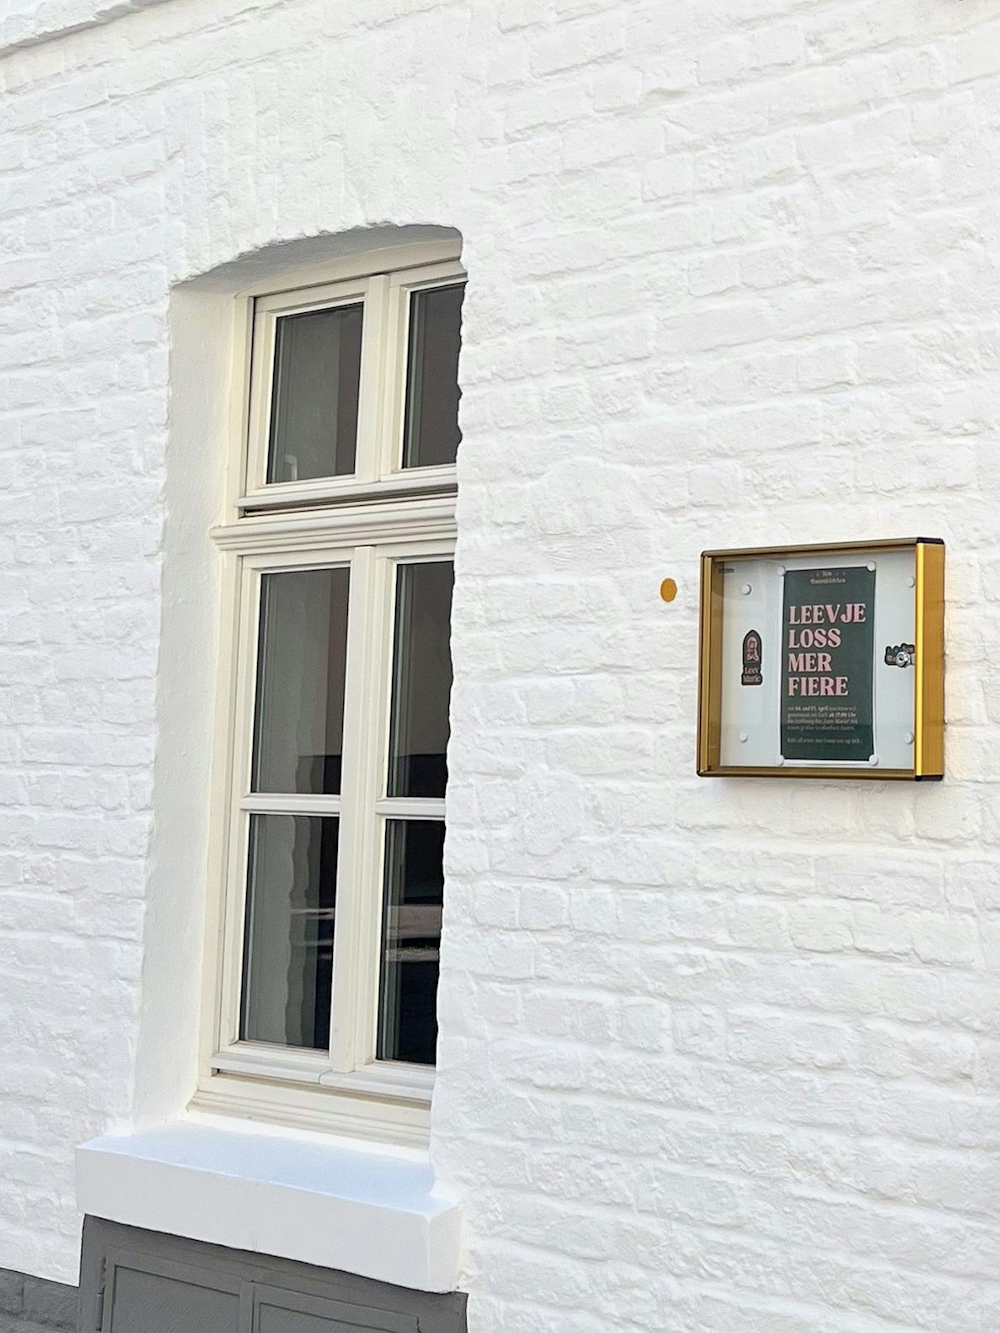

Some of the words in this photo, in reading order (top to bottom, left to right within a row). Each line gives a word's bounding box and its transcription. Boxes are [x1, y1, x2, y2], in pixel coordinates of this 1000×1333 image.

[788, 603, 866, 624] LEEVJE
[788, 628, 842, 649] LOSS
[788, 653, 832, 672] MER
[787, 676, 848, 697] FIERE
